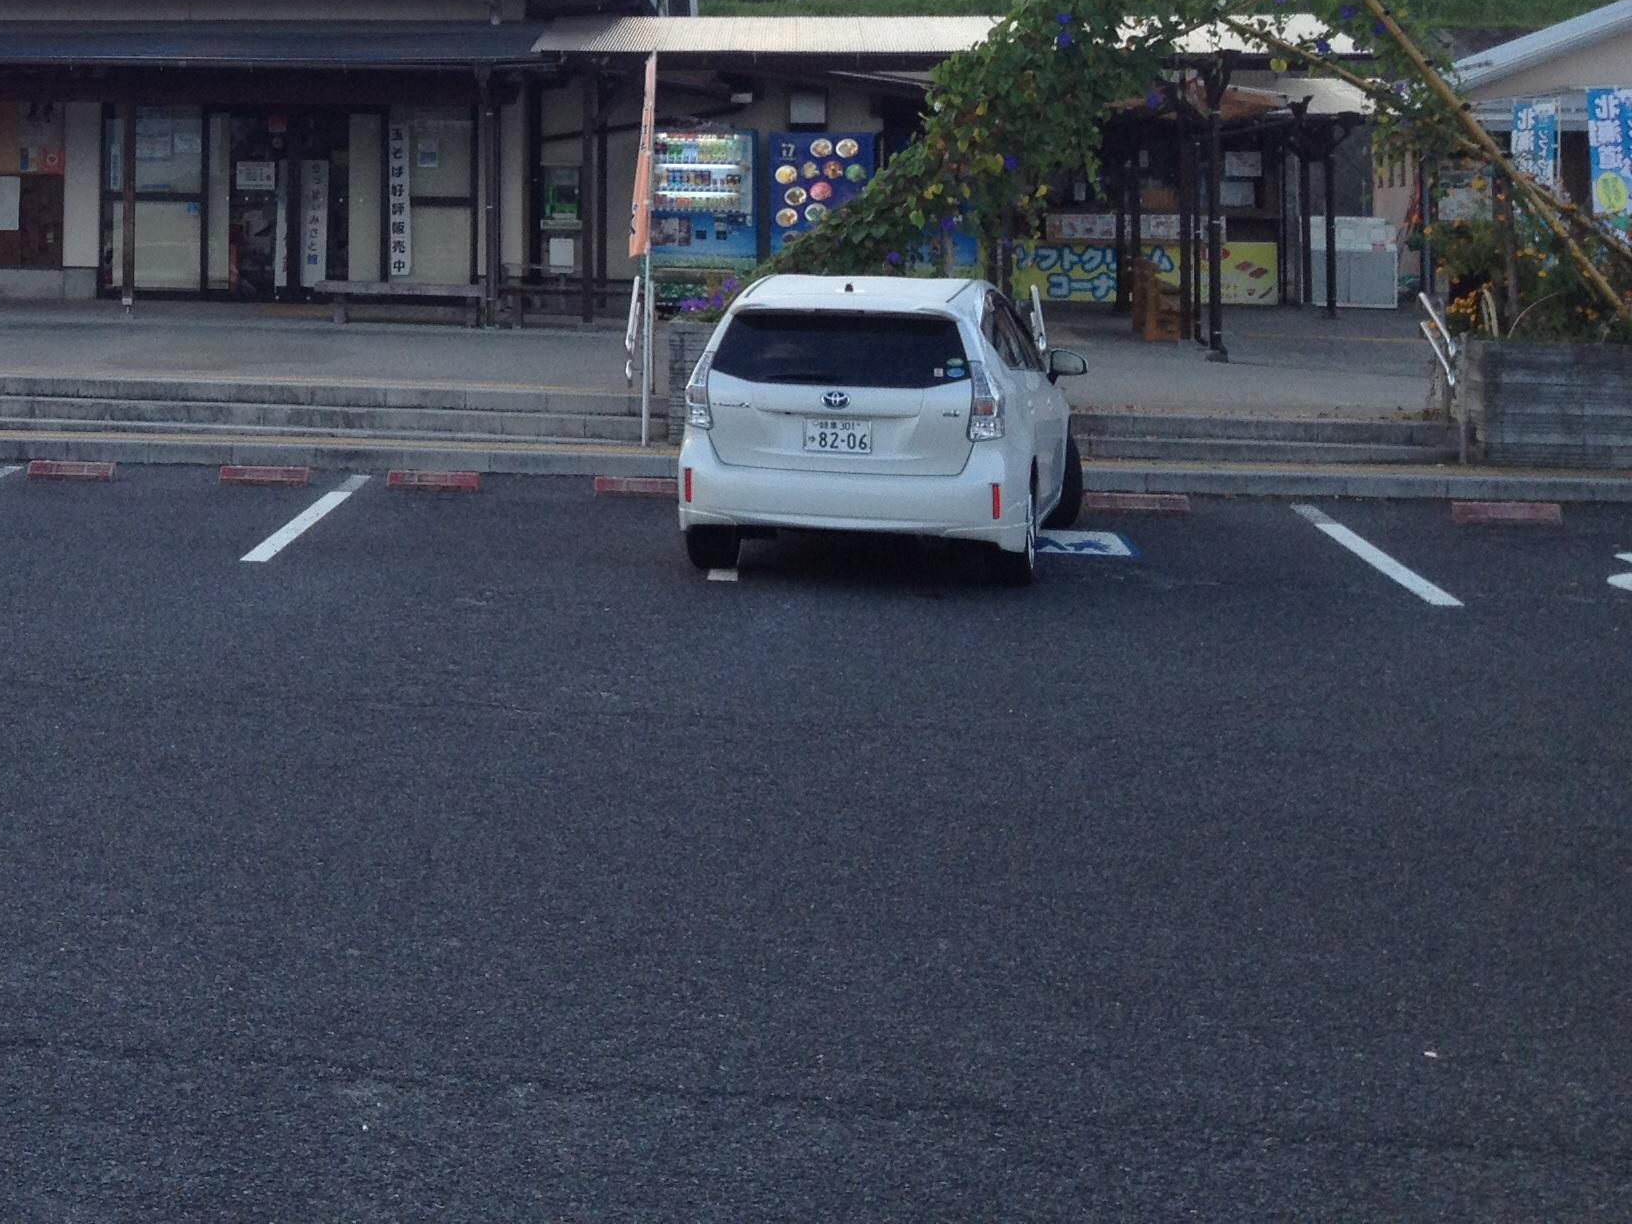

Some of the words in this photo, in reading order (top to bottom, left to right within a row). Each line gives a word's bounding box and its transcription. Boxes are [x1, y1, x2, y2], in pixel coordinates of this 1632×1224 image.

[1046, 272, 1117, 300] コーナ
[819, 432, 868, 450] 82-06
